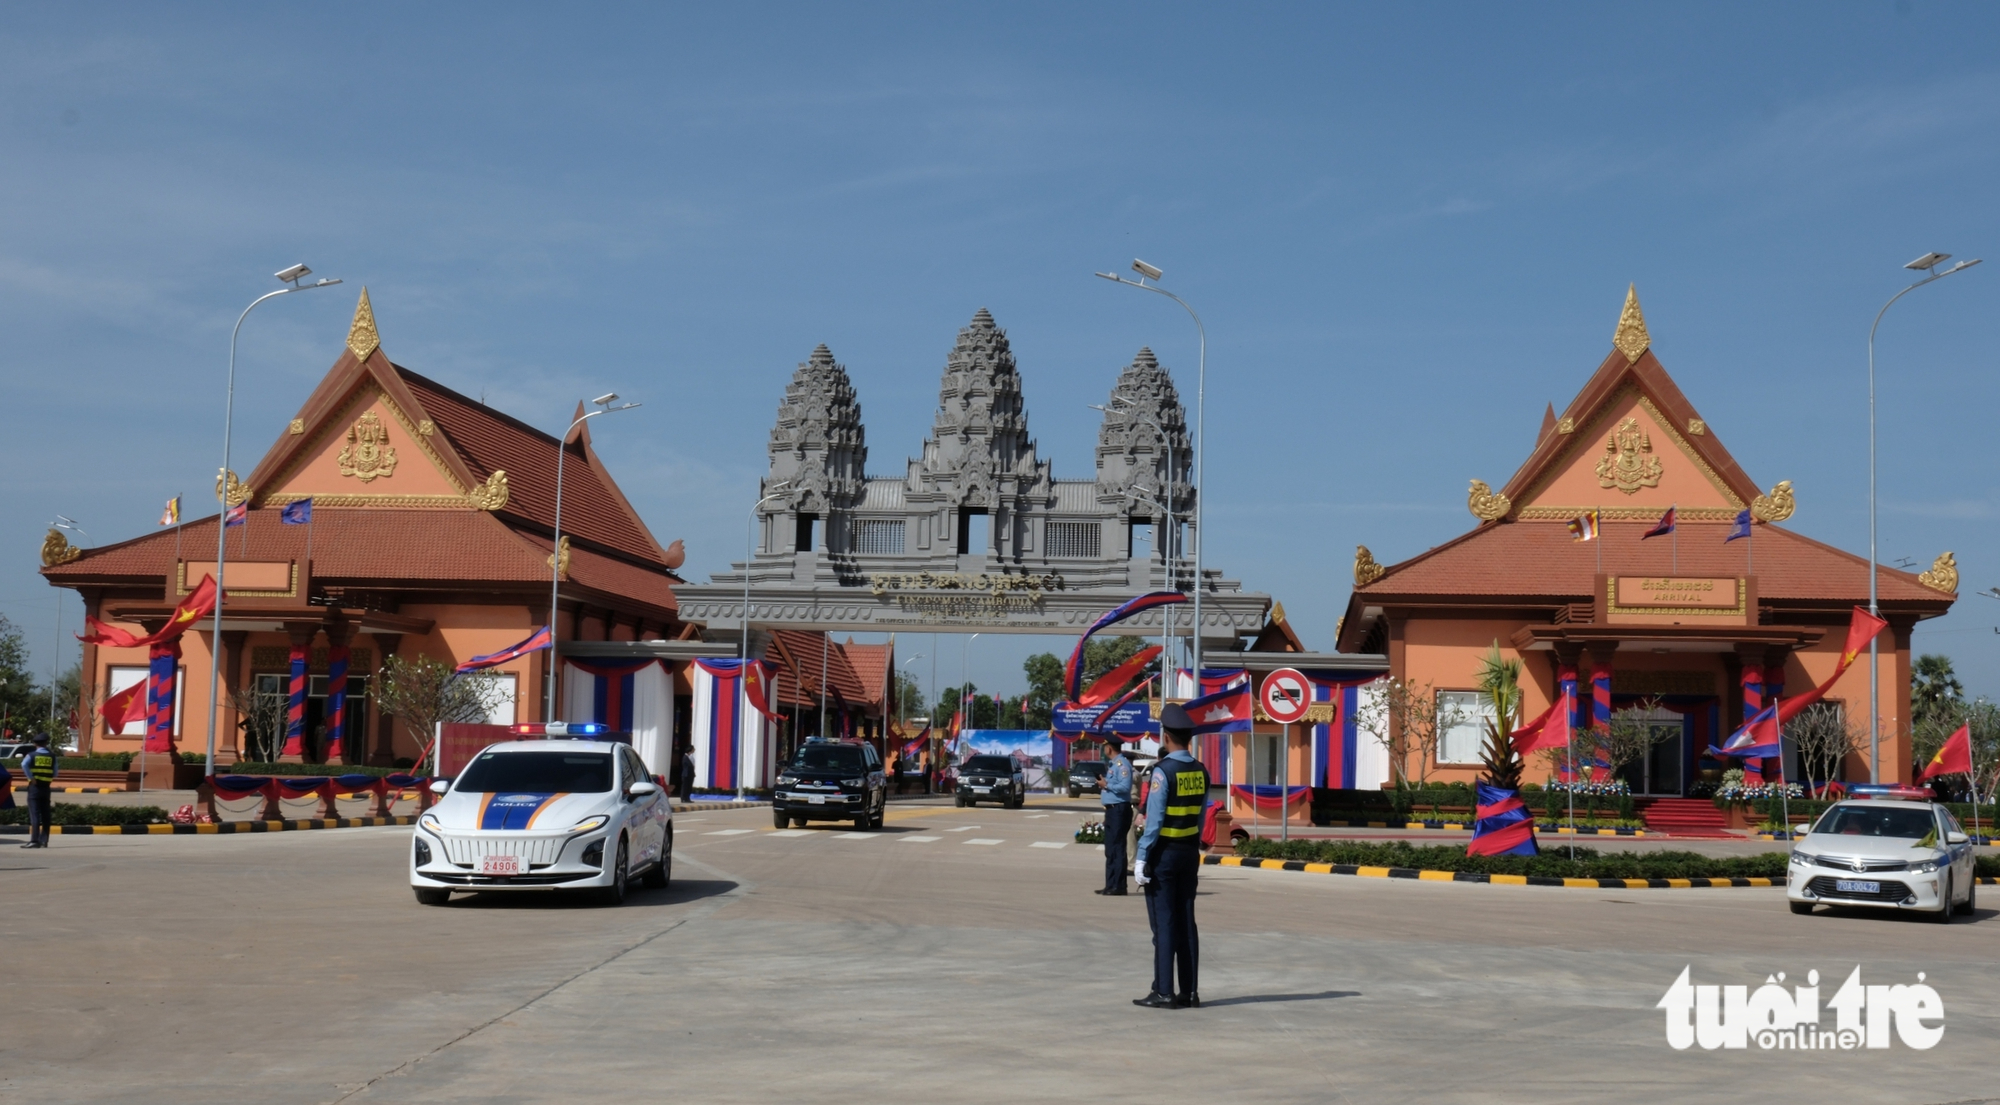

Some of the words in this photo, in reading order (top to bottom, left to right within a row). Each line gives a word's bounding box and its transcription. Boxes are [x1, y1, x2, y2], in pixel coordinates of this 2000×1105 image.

[896, 595, 951, 604] KINGDOM
[970, 596, 1032, 606] CAMBODIA
[1653, 593, 1702, 601] ARRIVAL
[1179, 777, 1203, 791] POLICE
